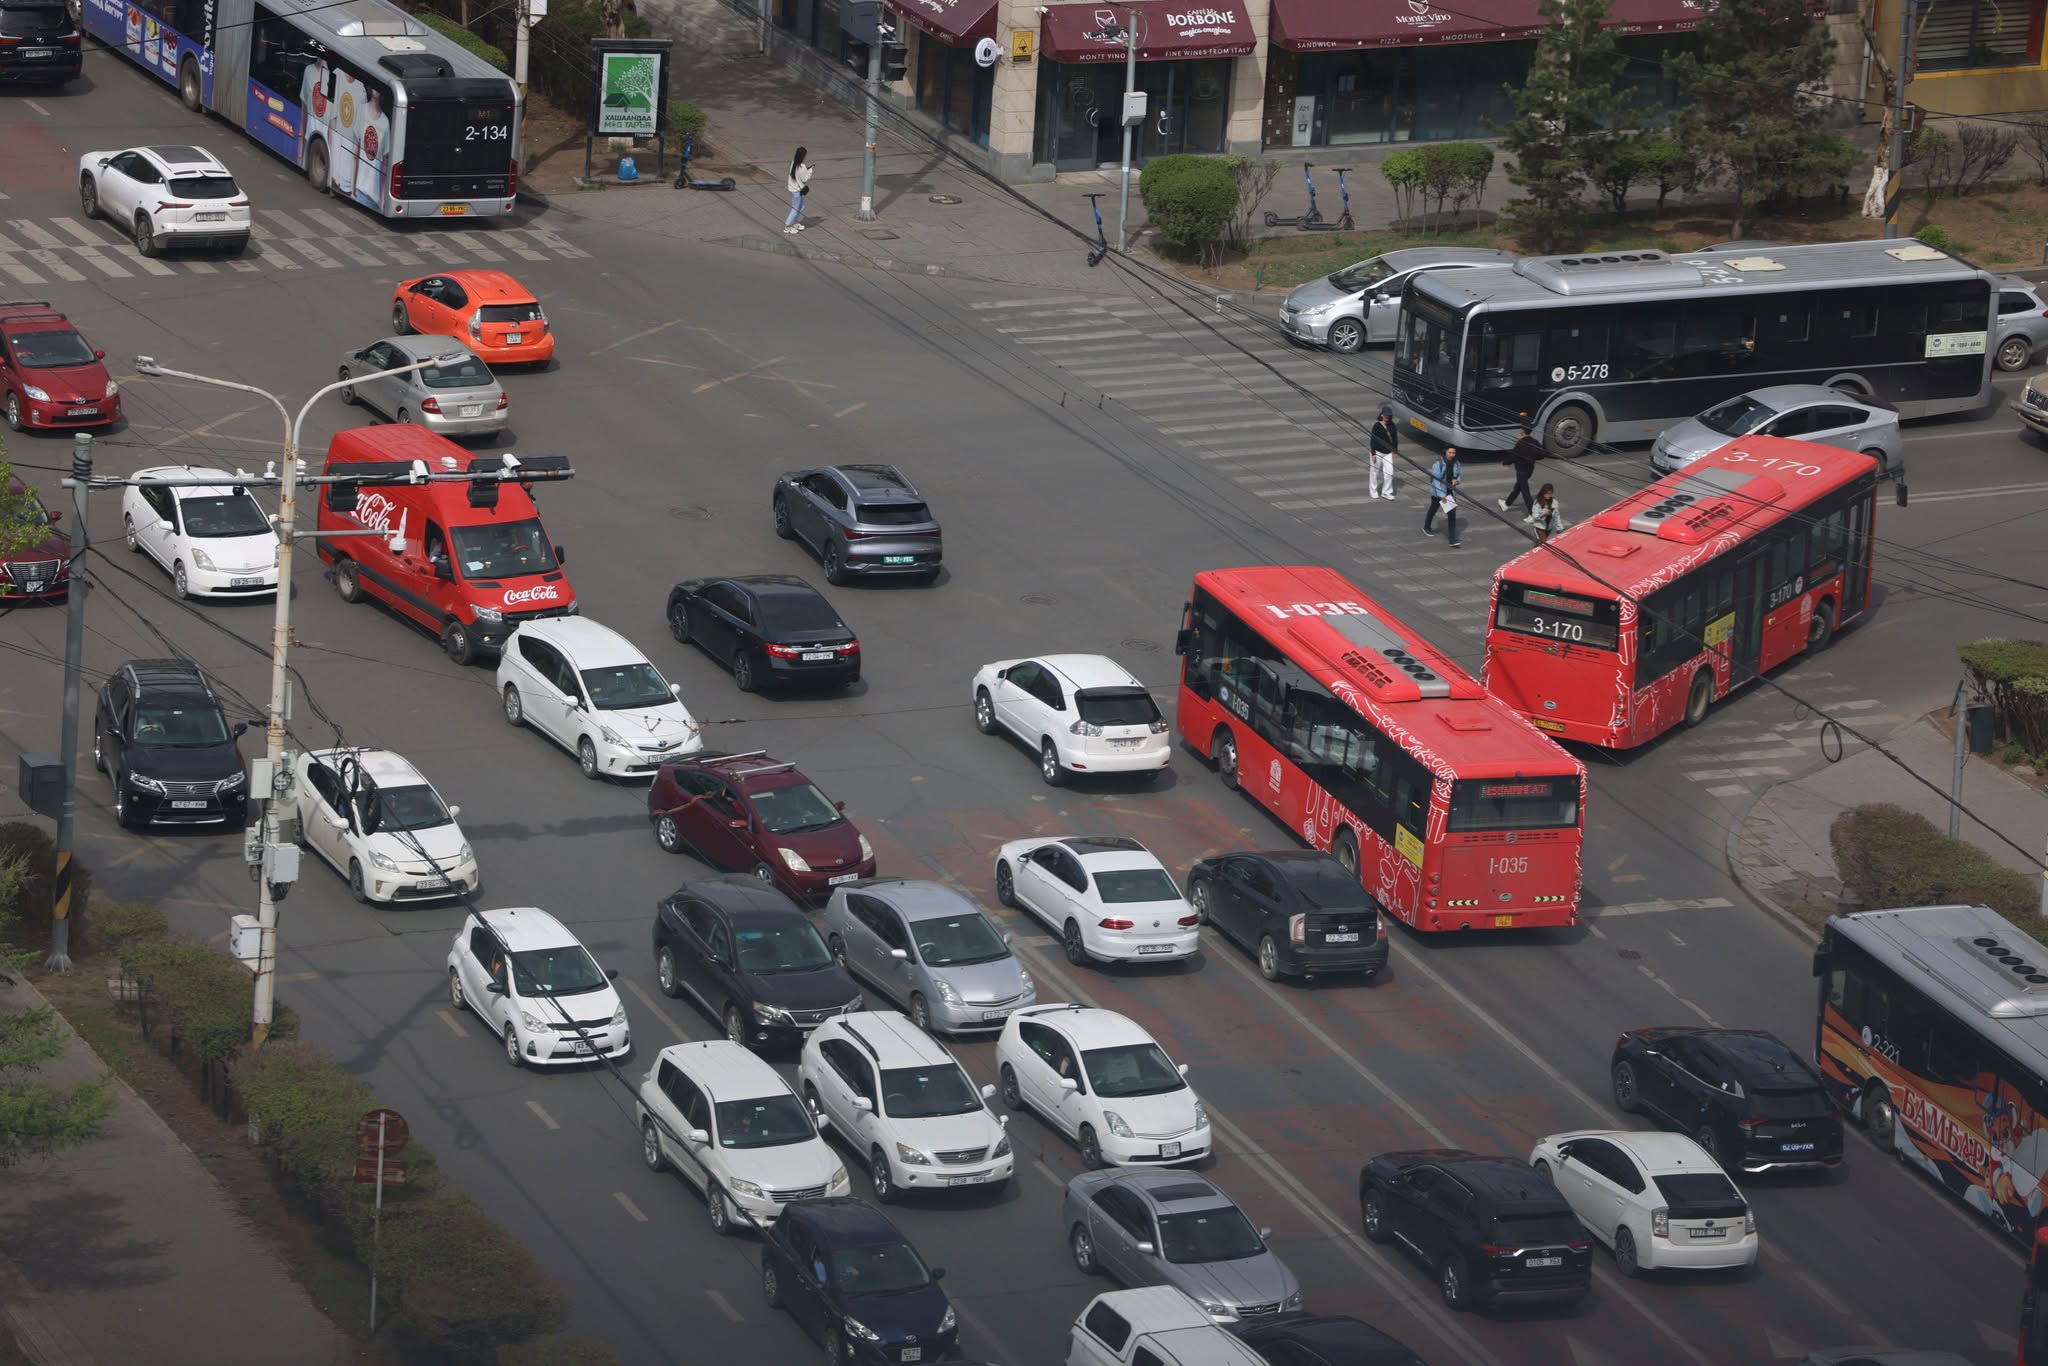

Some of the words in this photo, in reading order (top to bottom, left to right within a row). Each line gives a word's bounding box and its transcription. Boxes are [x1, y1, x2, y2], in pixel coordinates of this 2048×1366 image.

[1166, 11, 1236, 26] BORBONE
[1395, 15, 1427, 23] Monte
[1427, 13, 1451, 21] Vino
[1297, 41, 1337, 49] SANDWICH
[1441, 33, 1484, 41] SMOOTHIES
[465, 125, 507, 140] 2-134
[1567, 364, 1608, 381] 5-278
[1723, 451, 1821, 476] 3-170
[504, 585, 559, 605] Coca-Cola
[1769, 583, 1792, 608] 3-170
[1533, 617, 1583, 641] 3-170
[1873, 1034, 1900, 1065] 2-221
[1902, 1086, 1986, 1171] БАМБАР
